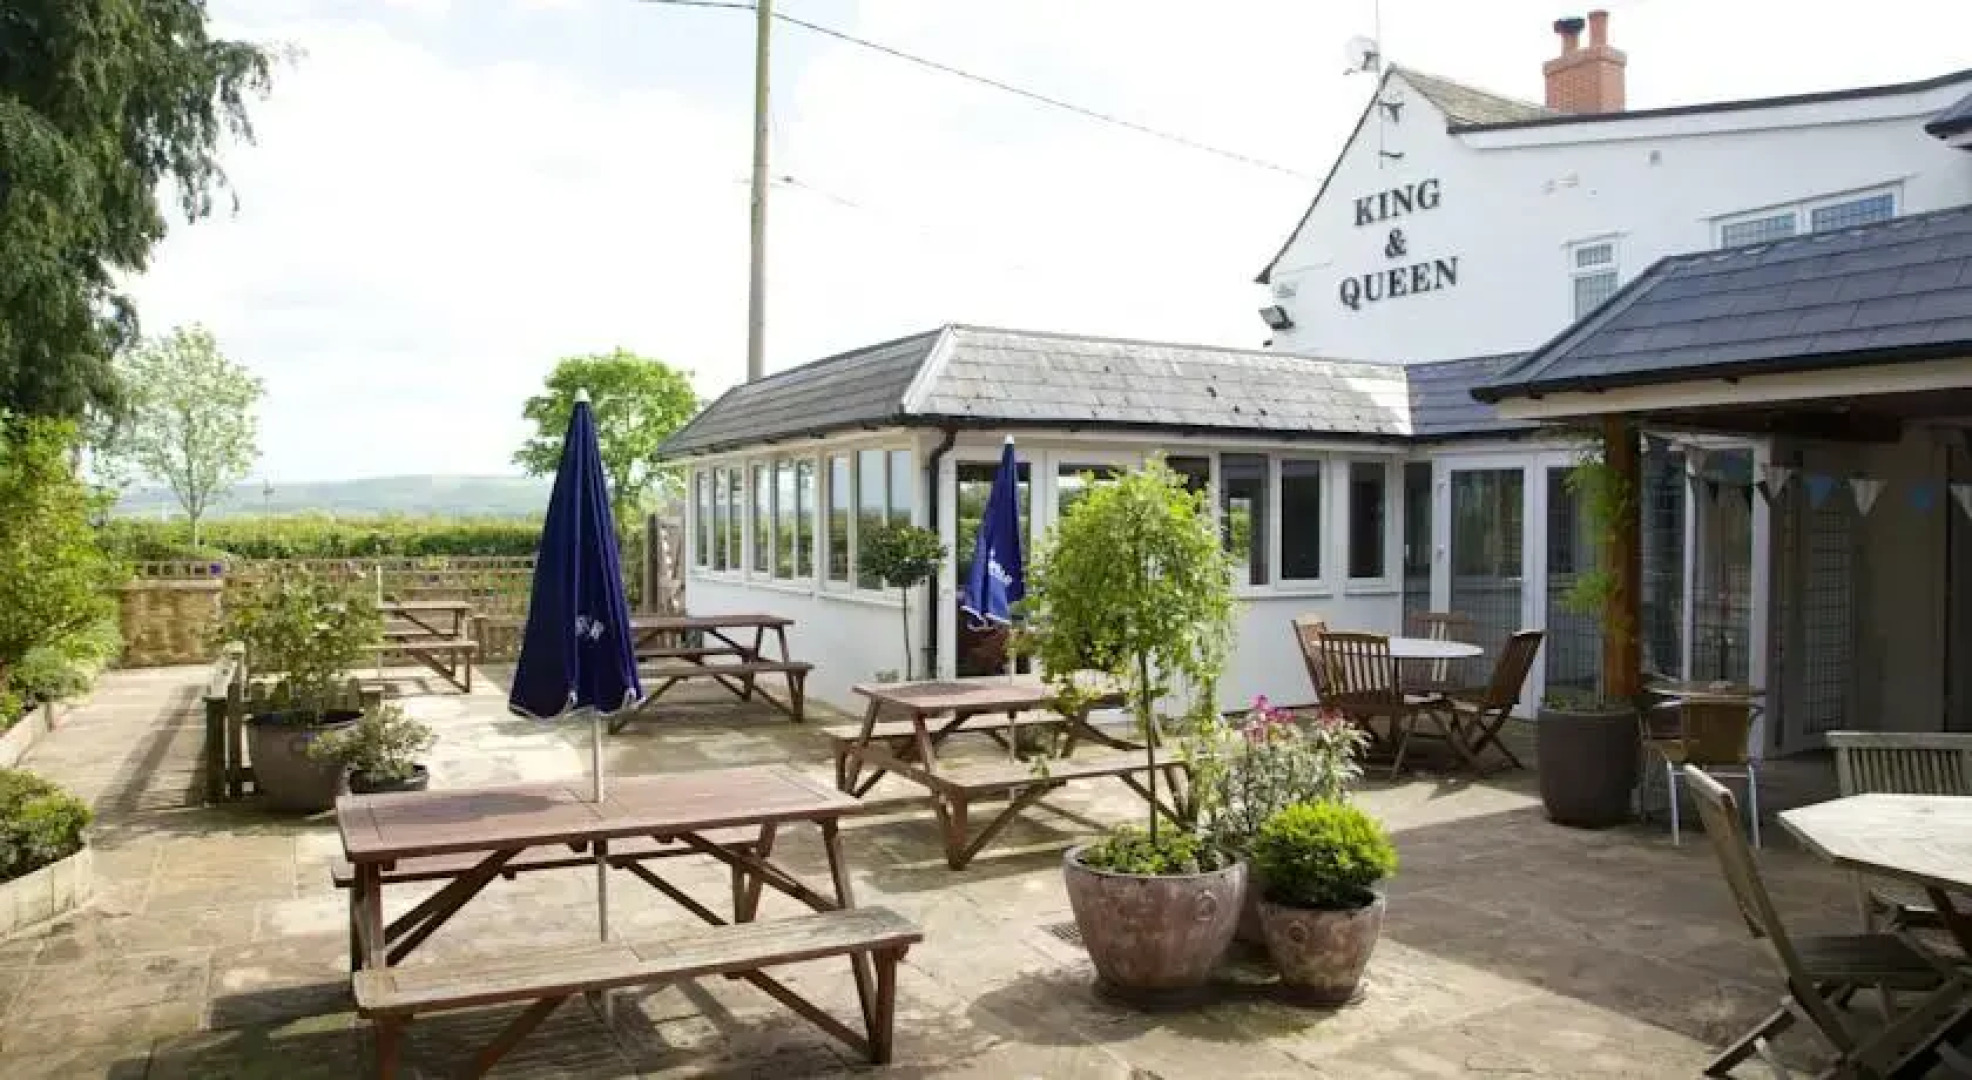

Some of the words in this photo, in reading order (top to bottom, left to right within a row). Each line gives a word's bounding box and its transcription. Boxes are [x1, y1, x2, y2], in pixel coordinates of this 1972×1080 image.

[1354, 178, 1441, 226] KING
[1385, 227, 1407, 258] &
[1339, 256, 1459, 310] QUEEN
